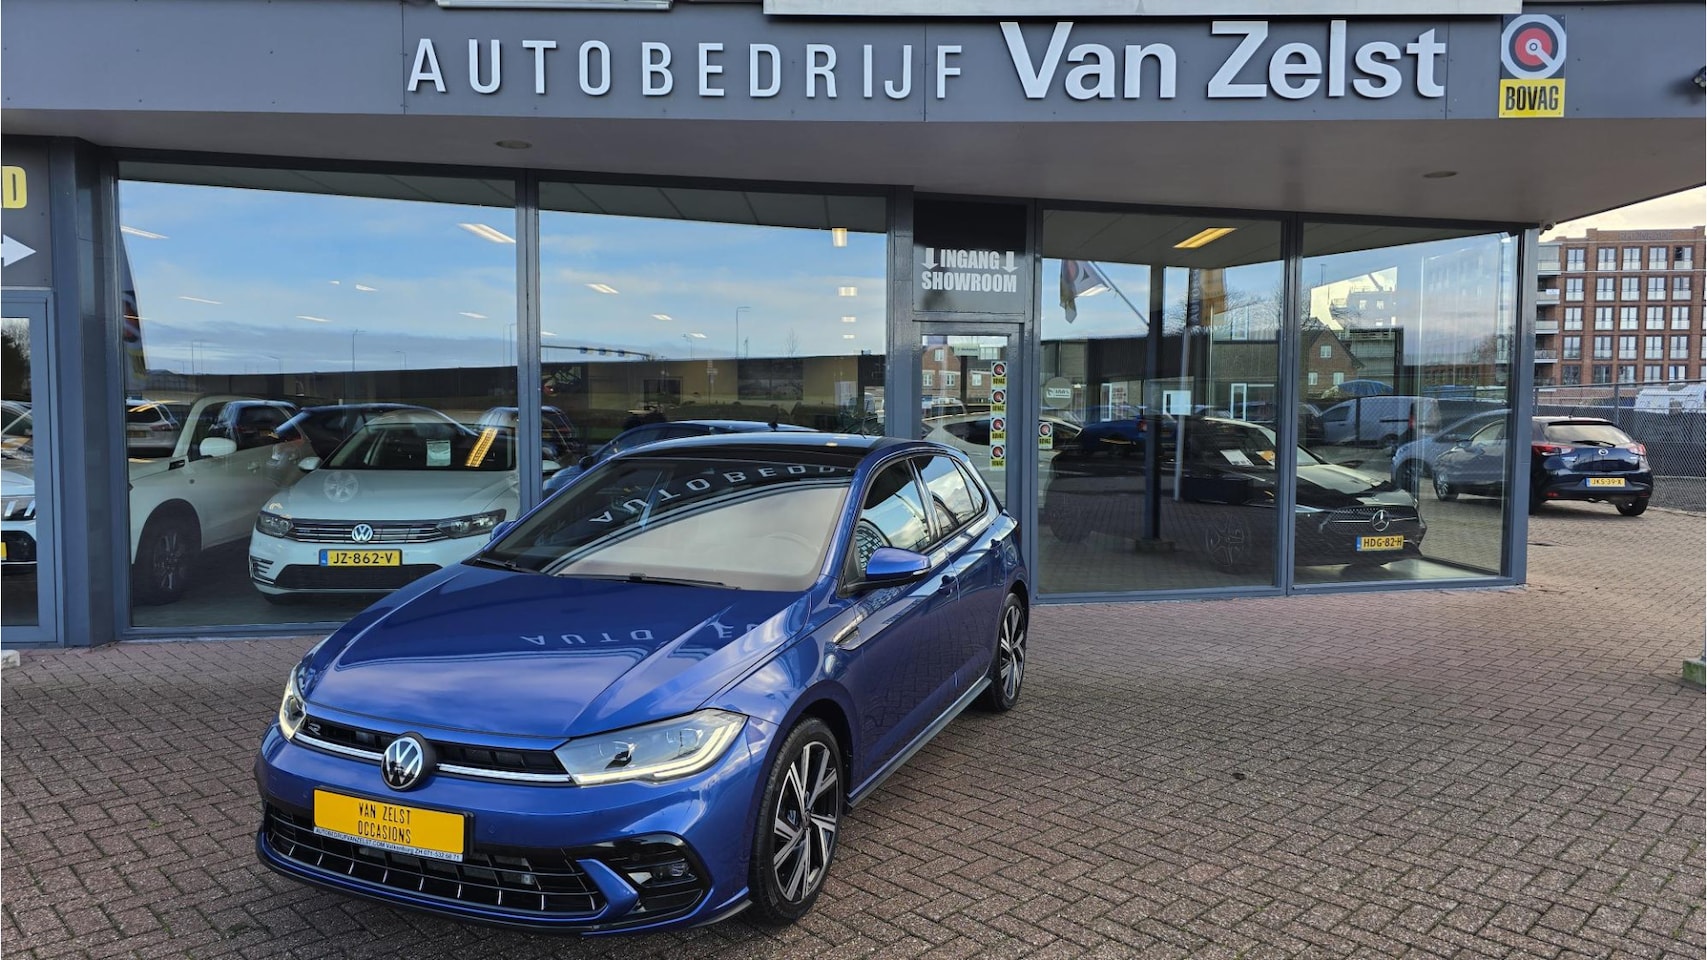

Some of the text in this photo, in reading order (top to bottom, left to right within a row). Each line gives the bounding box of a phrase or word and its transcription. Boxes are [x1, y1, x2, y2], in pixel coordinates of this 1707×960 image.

[406, 20, 1446, 100] AUTOBEDRIJF Van Zelst
[1505, 85, 1559, 112] BOVAG
[940, 249, 1000, 270] INGANG
[921, 271, 1017, 293] SHOWROOM
[1363, 538, 1403, 548] HDG-82-H
[333, 552, 393, 564] JZ-862-V
[359, 802, 411, 825] VAN ZELST
[357, 820, 411, 844] OCCASIONS
